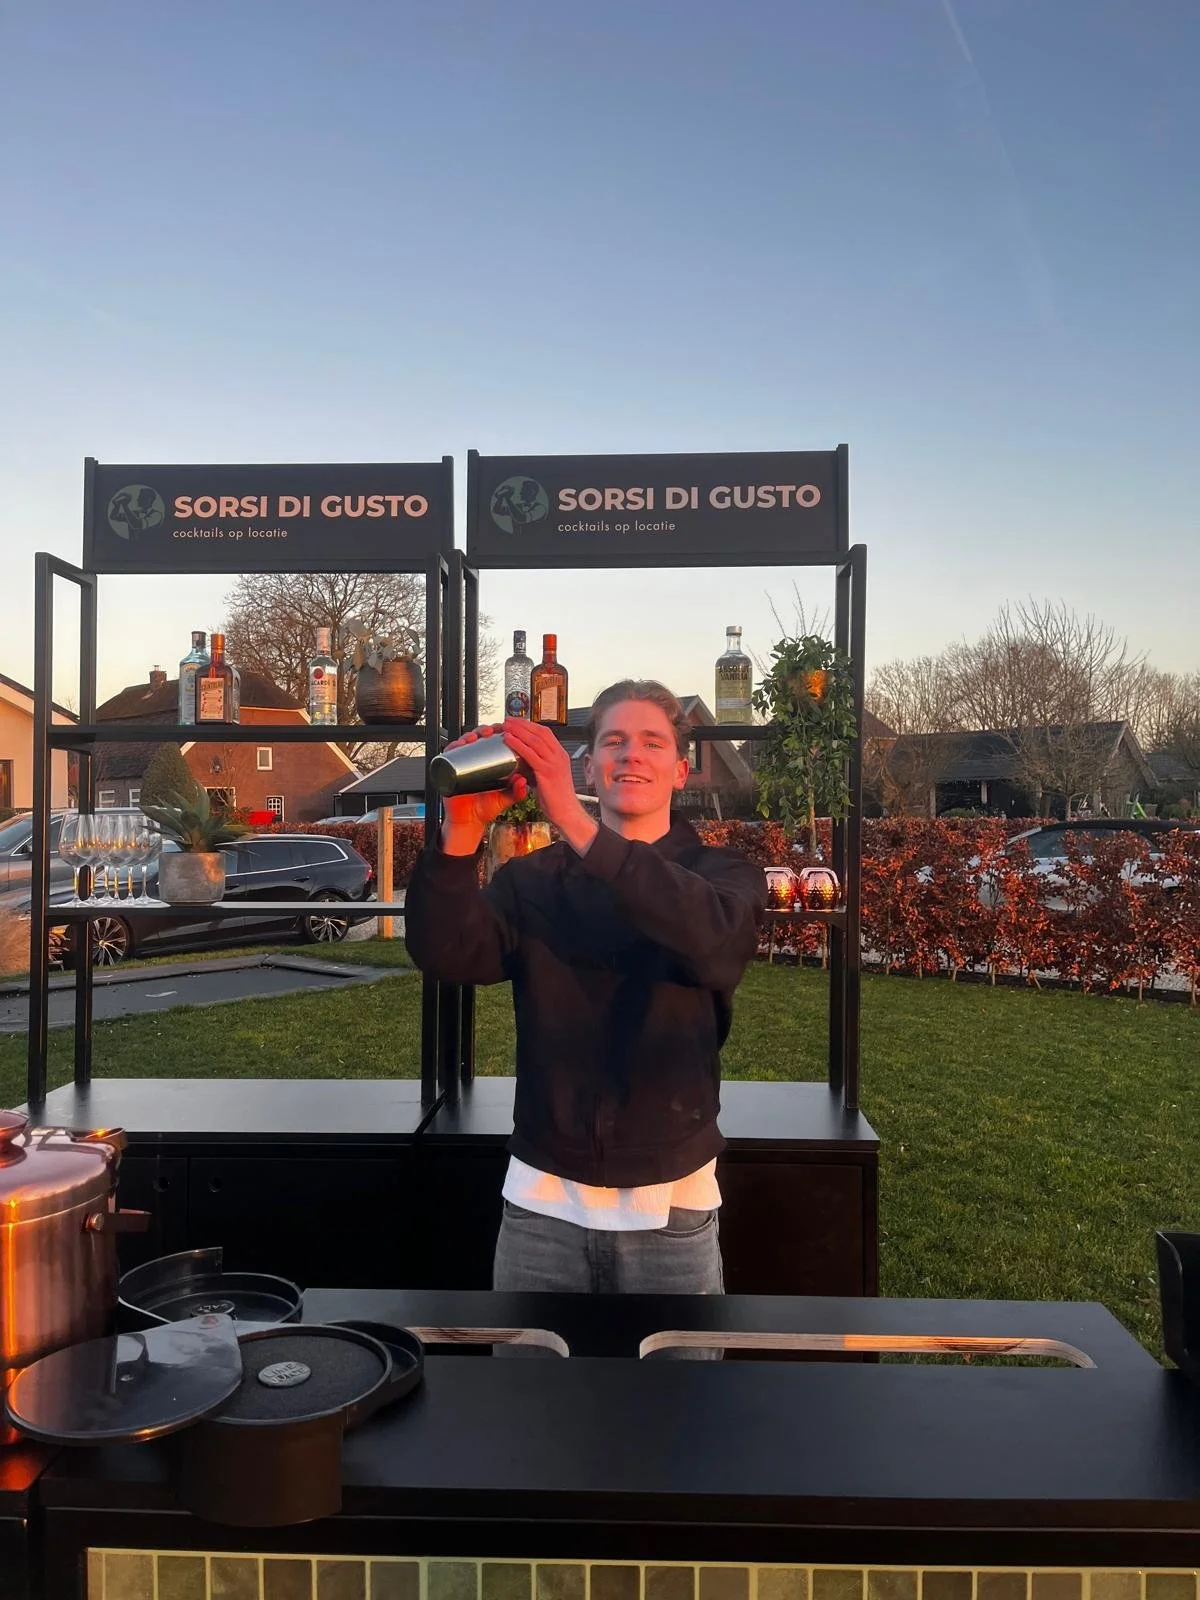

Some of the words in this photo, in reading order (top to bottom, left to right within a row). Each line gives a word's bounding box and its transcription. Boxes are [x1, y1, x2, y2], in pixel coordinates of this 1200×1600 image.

[558, 487, 654, 512] SORSI
[665, 486, 699, 510] DI
[709, 484, 821, 510] GUSTO
[173, 495, 268, 519] SORSI
[278, 495, 311, 518] DI
[320, 494, 429, 519] GUSTO
[172, 526, 224, 538] cocktails
[228, 528, 244, 541] op
[248, 526, 288, 538] locatie
[557, 520, 610, 532] cocktails
[614, 522, 630, 535] op
[635, 520, 676, 531] locatie
[263, 1362, 297, 1377] LIME
[271, 1367, 308, 1384] JUICE
